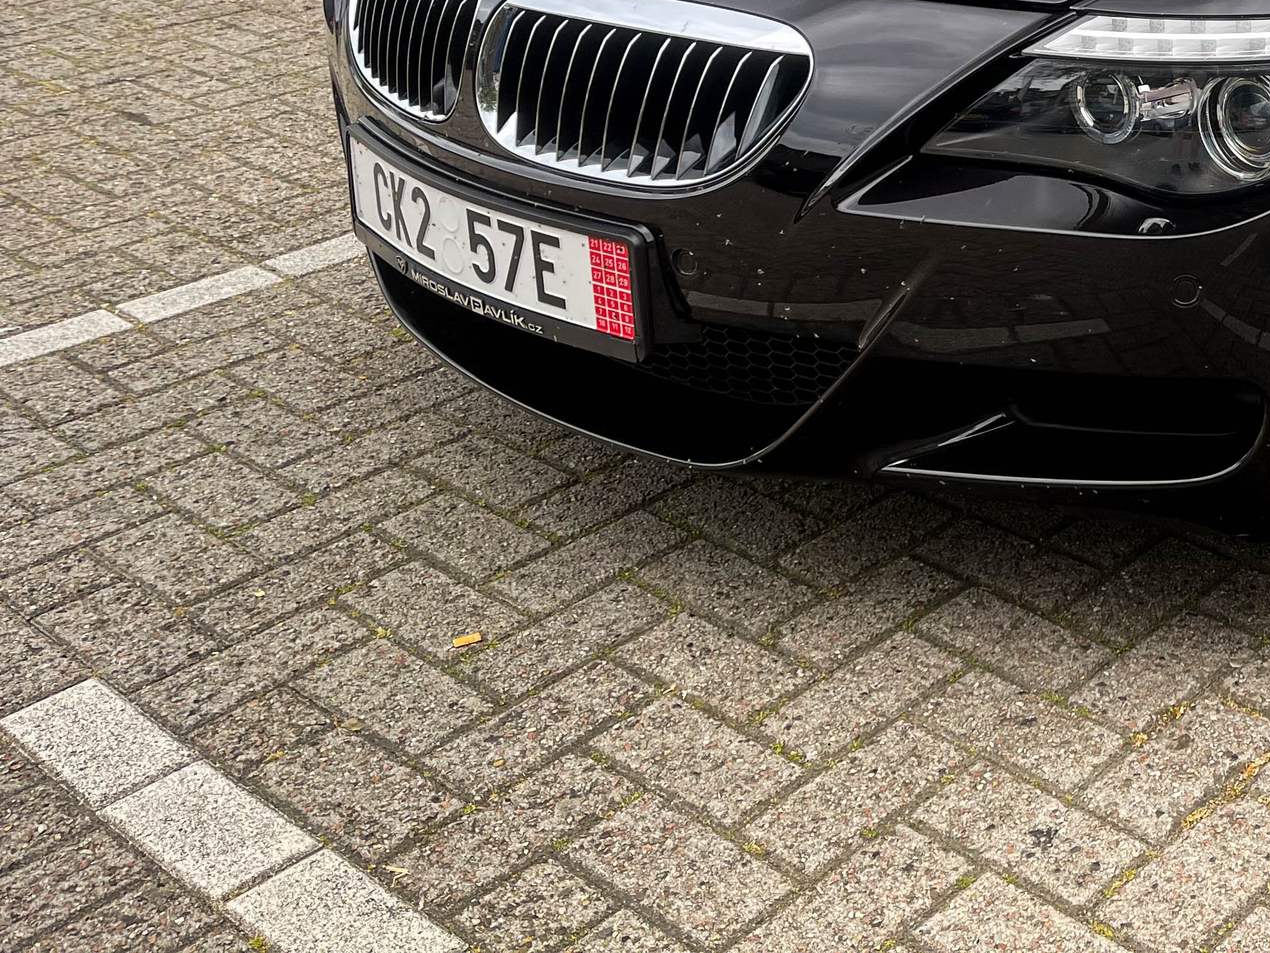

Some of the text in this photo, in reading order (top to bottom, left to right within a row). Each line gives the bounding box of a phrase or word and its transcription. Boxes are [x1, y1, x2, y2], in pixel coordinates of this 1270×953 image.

[373, 161, 567, 310] CK2 57E
[590, 239, 599, 248] 21
[602, 242, 612, 252] 22
[591, 255, 627, 271] 24 25 26
[593, 271, 629, 287] 27 28 29
[599, 319, 633, 335] 10 11 12
